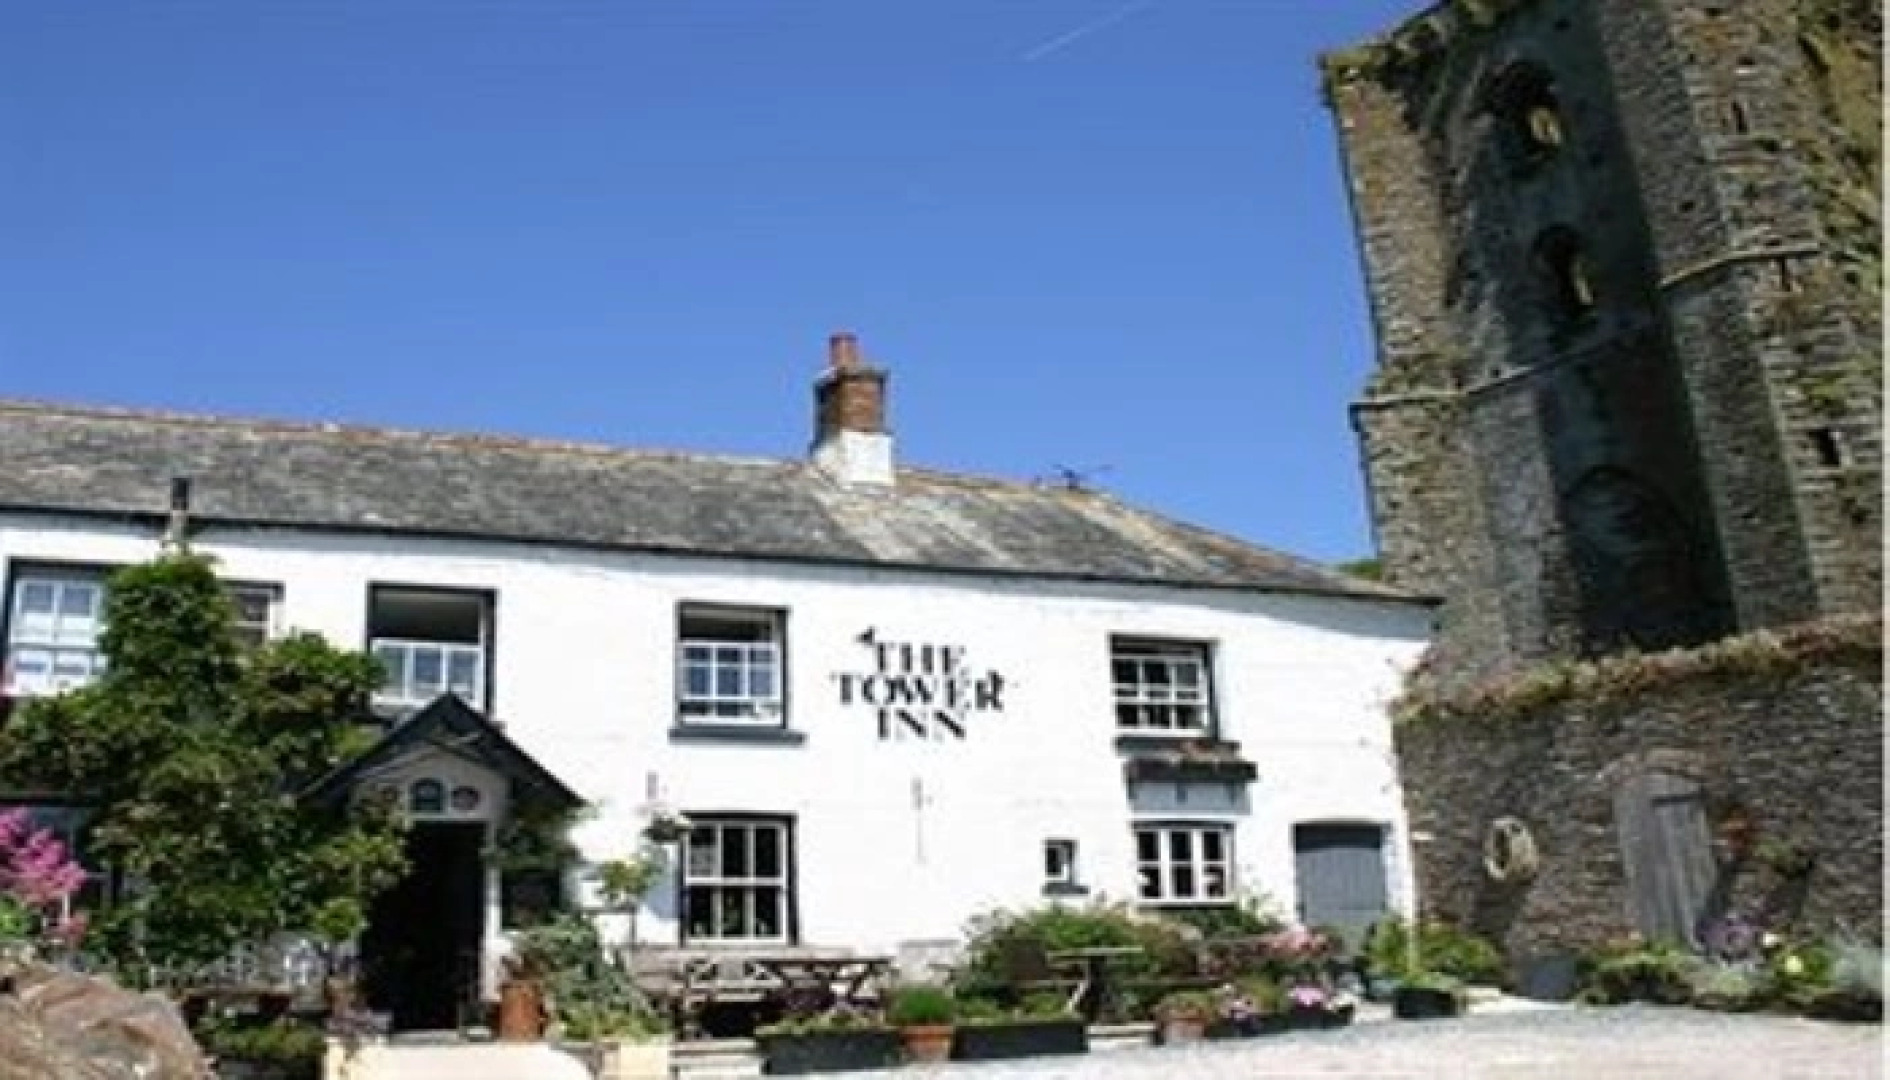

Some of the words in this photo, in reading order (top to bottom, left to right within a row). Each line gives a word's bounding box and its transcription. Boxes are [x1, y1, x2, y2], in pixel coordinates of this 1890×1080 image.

[869, 641, 968, 676] THE
[830, 669, 1004, 711] TOWER
[876, 705, 967, 741] INN
